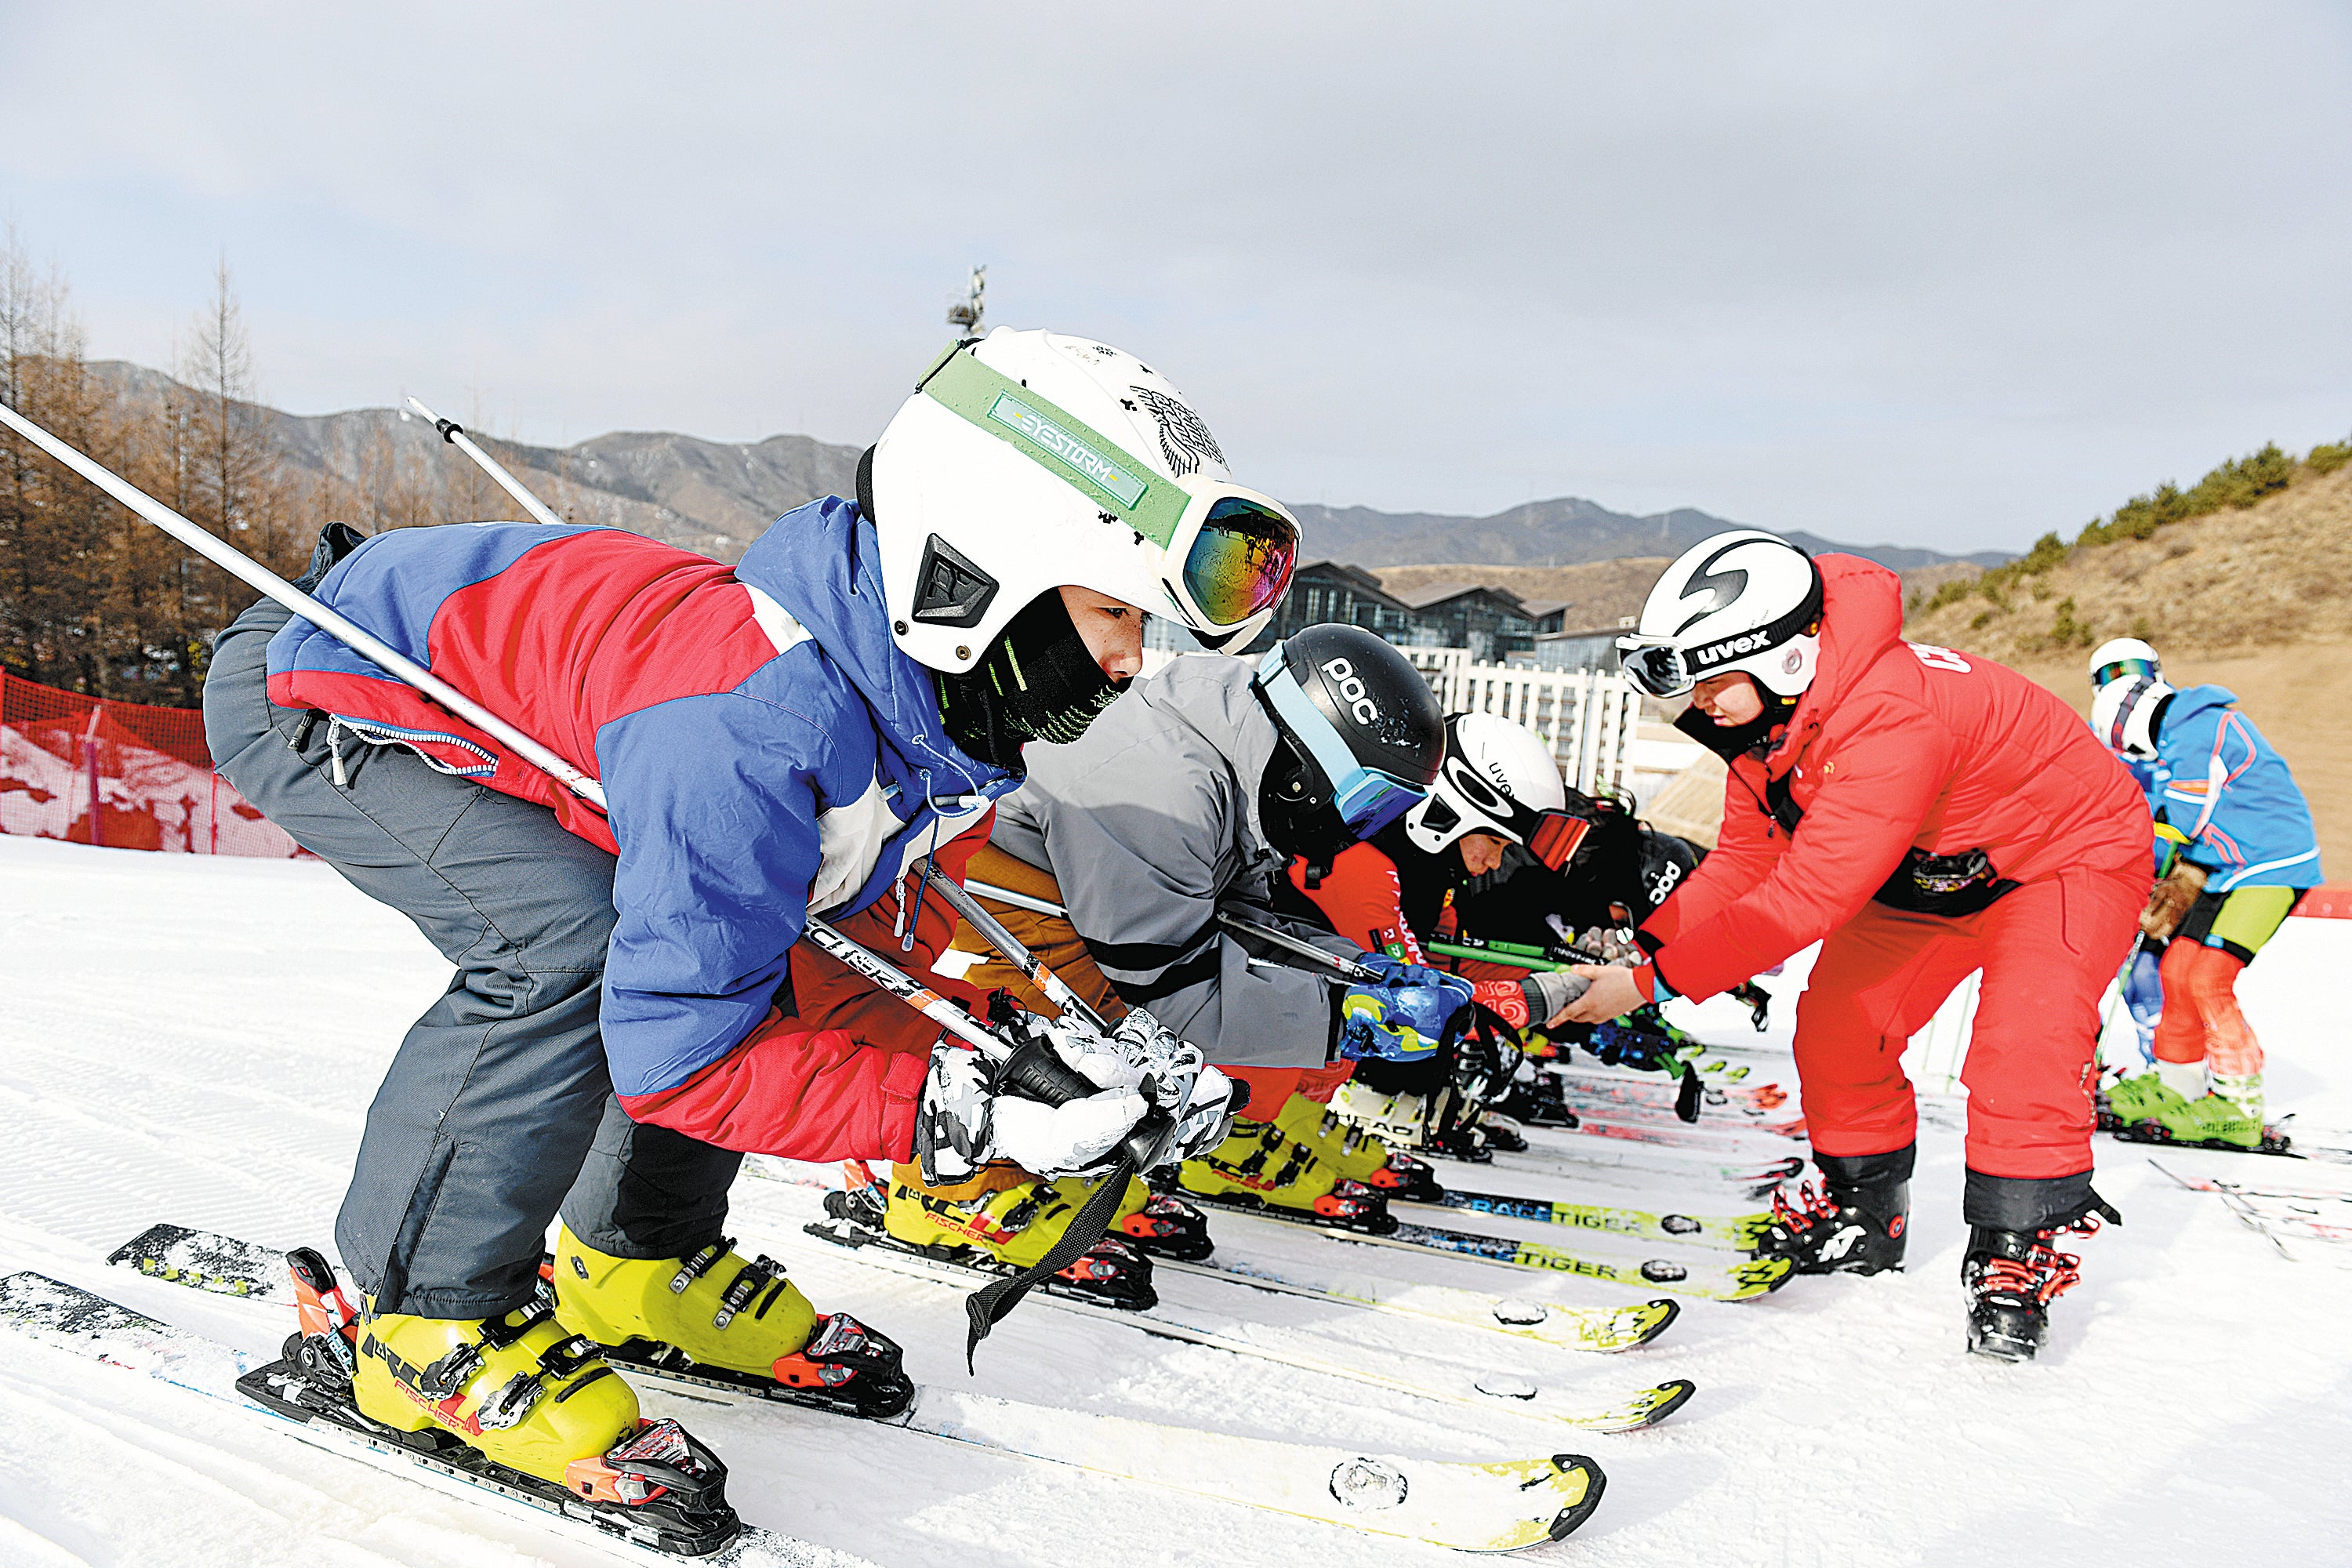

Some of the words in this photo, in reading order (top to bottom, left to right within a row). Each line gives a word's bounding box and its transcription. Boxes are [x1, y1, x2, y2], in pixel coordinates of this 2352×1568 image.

[1021, 414, 1113, 482] EYESTORM
[1697, 630, 1772, 665] uvex
[1320, 657, 1378, 725] POC
[1489, 762, 1515, 800] uve
[1649, 860, 1681, 905] POC
[924, 1212, 985, 1242] FISCHER
[1519, 1250, 1618, 1279] TIGER
[394, 1379, 459, 1433] FISCHER
